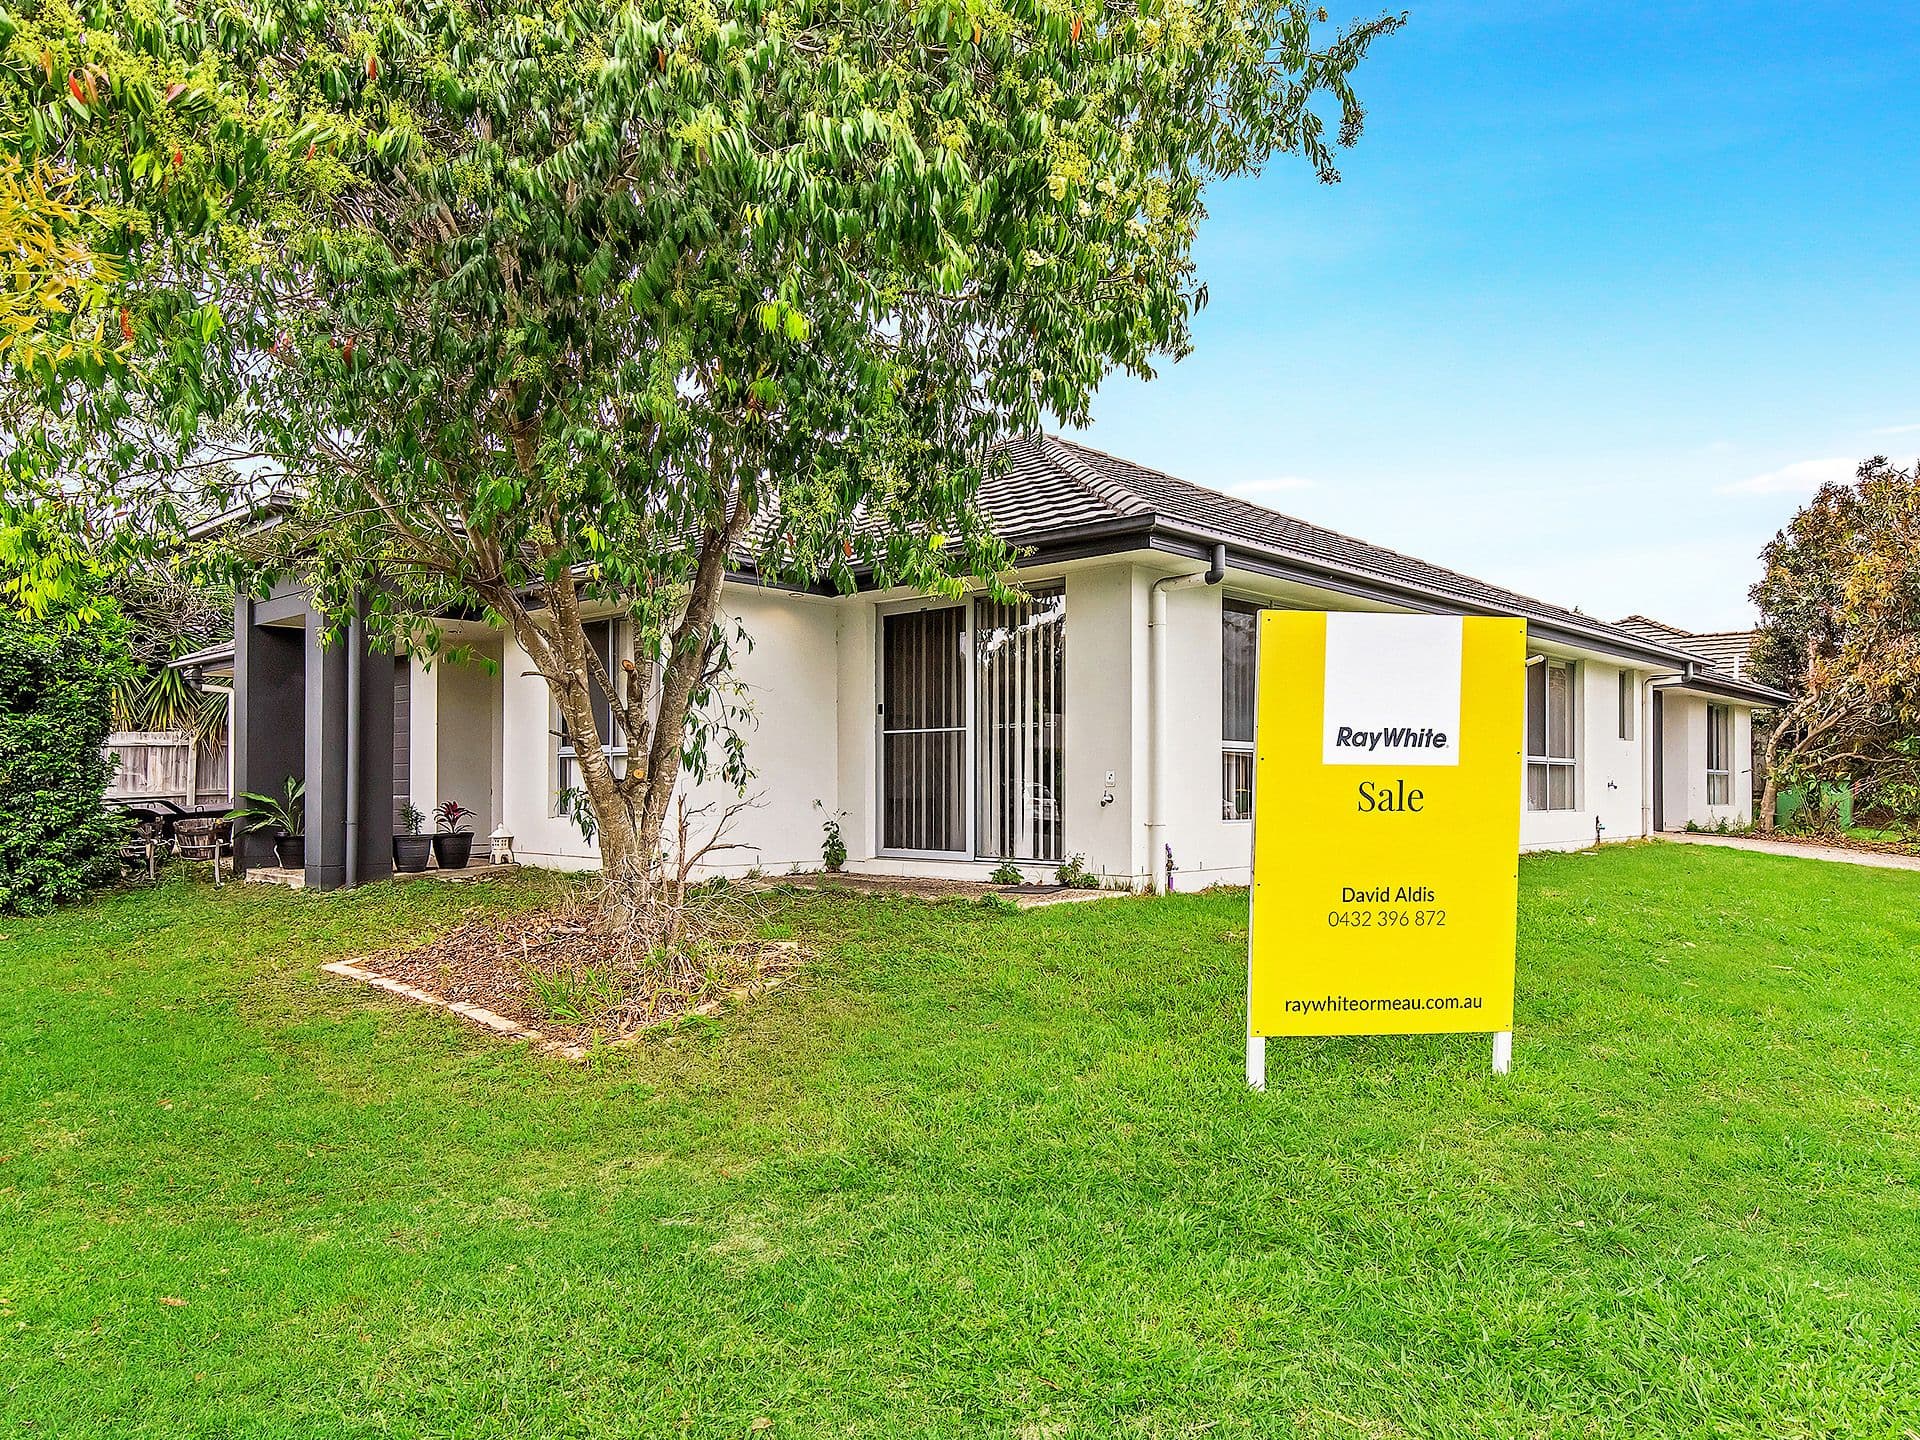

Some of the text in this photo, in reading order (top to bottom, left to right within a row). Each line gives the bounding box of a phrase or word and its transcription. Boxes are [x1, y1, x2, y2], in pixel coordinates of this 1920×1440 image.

[1357, 779, 1424, 812] Sale
[1342, 886, 1435, 902] David Aldis
[1328, 910, 1446, 927] 0432 396 872
[1285, 995, 1482, 1015] raywhiteormeau.com.au
